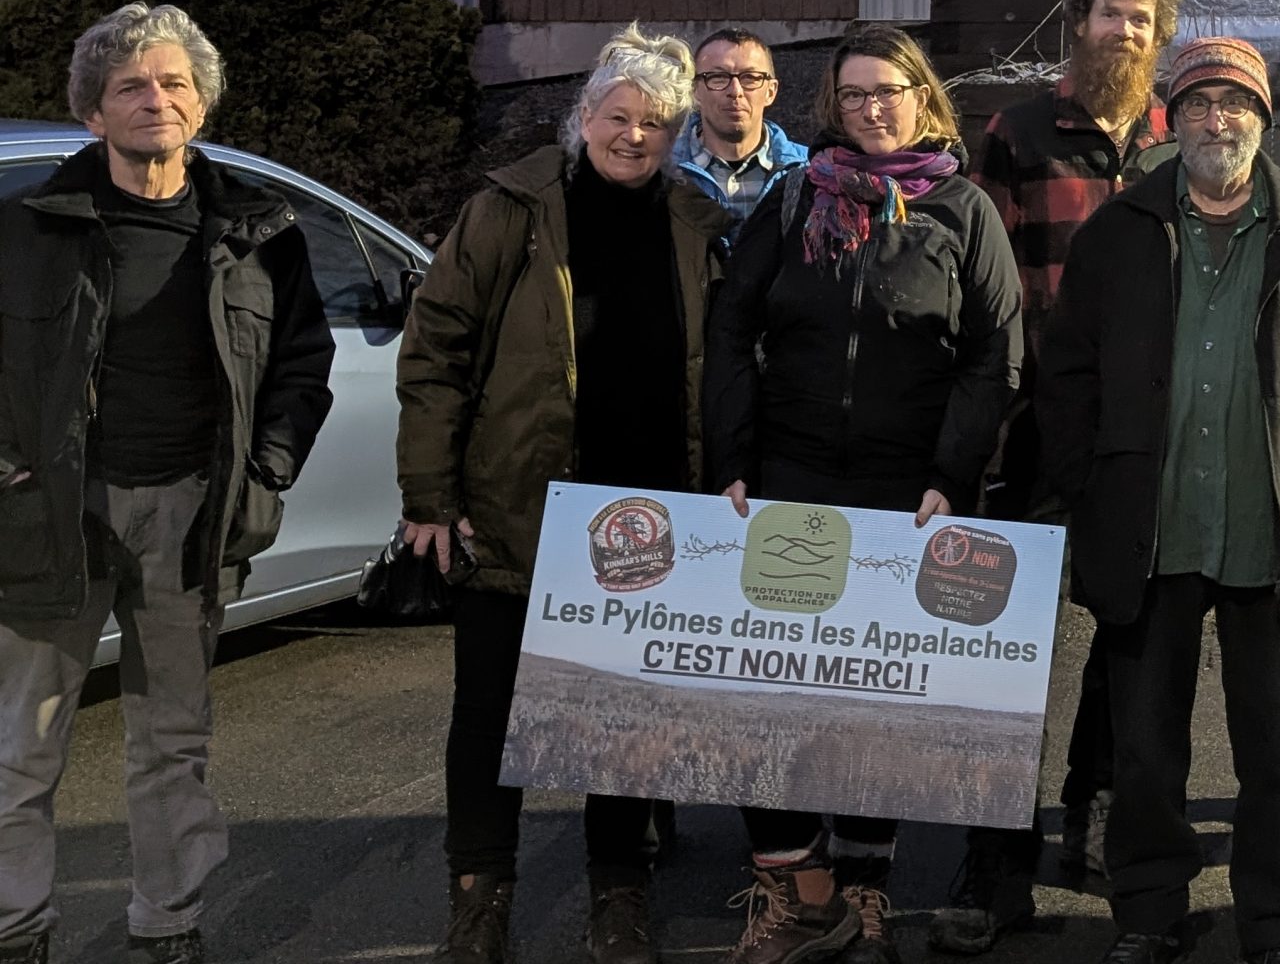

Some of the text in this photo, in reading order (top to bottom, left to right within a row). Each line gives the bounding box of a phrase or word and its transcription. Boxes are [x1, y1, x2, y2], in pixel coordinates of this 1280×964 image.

[603, 557, 640, 570] KINNEAR'S
[640, 551, 663, 563] MILLS
[971, 550, 1000, 569] NON!
[744, 586, 837, 601] PROTECTION DES
[754, 594, 825, 606] APPALACHES
[542, 593, 1038, 663] Les Pylônes dans les Appalaches
[643, 640, 733, 674] C'EST
[739, 647, 807, 681] NON
